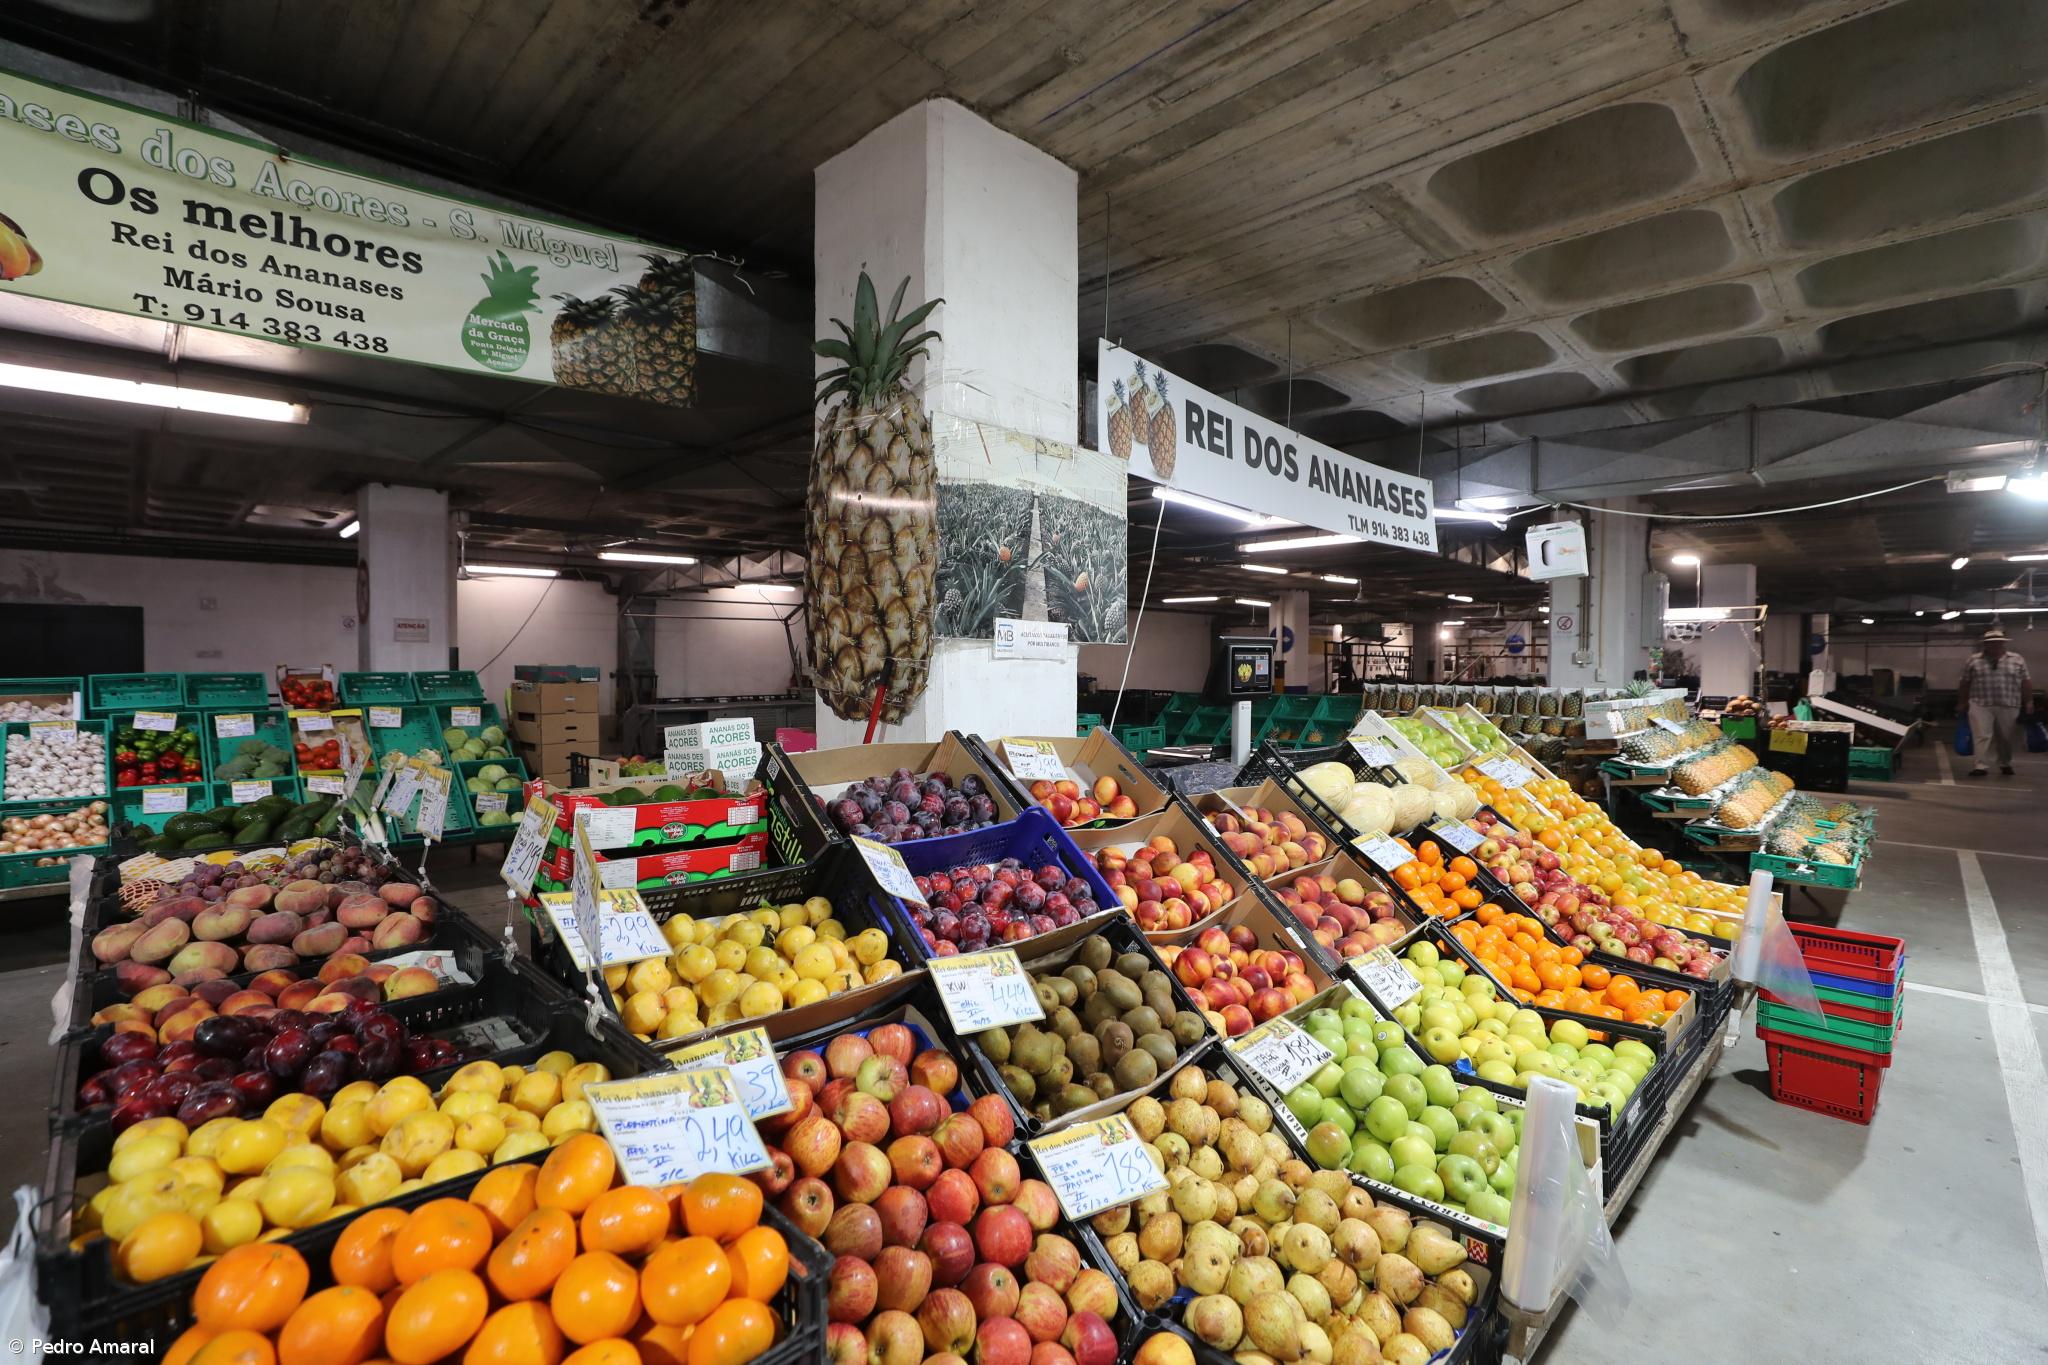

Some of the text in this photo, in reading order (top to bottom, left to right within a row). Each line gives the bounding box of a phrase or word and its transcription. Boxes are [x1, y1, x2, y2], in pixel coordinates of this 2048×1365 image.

[141, 129, 236, 188] dos
[250, 161, 411, 227] Açores
[449, 208, 489, 243] S.
[499, 219, 620, 272] Miguel
[78, 167, 424, 274] Os melhores
[111, 221, 404, 301] Rei dos Ananases
[163, 266, 366, 323] Mário Sousa
[133, 292, 389, 354] T: 914 383 438
[470, 314, 523, 332] Mercado
[468, 328, 525, 345] da Graça
[1186, 399, 1428, 520] REI DOS ANANASES
[1348, 514, 1430, 546] TLM 914 383 438
[710, 730, 751, 745] AÇORES
[736, 722, 750, 731] DOS
[717, 755, 758, 770] AÇORES
[743, 747, 757, 755] DOS
[669, 761, 705, 772] AÇORES
[991, 982, 1028, 1012] 4,49
[676, 1049, 719, 1066] Ananases
